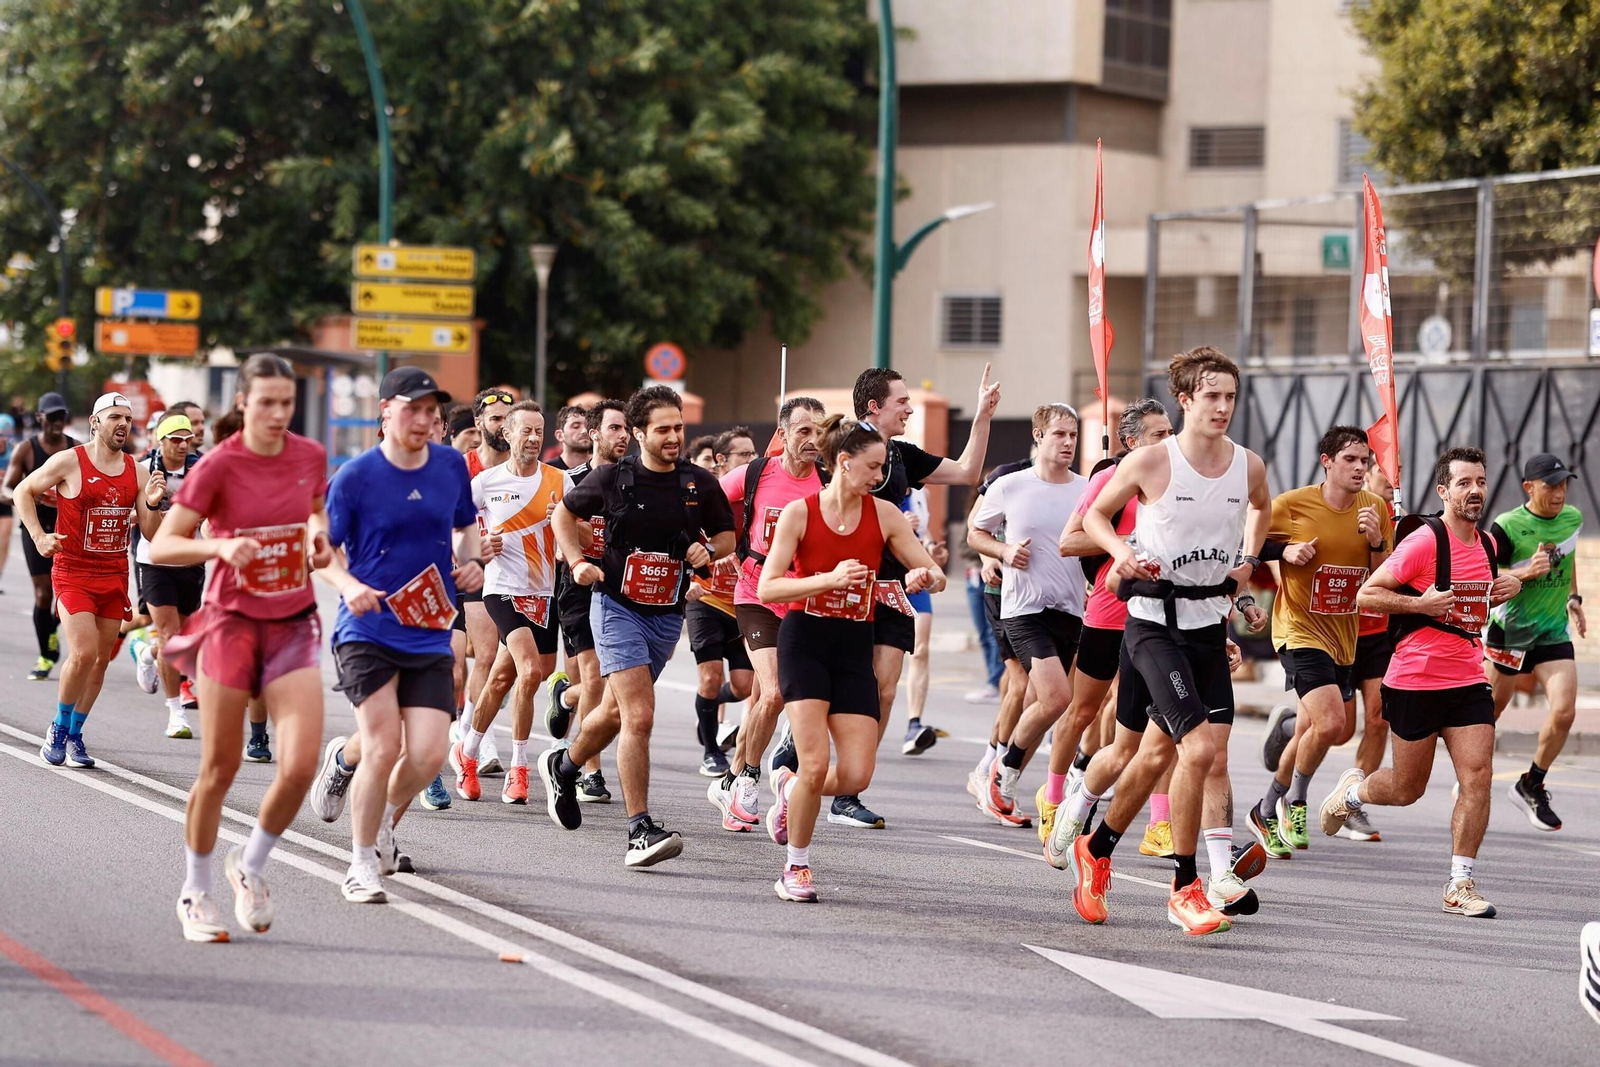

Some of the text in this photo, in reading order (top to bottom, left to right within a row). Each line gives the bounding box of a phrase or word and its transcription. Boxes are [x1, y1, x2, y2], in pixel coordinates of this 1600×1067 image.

[101, 519, 118, 528] 537
[640, 565, 668, 577] 3665
[1328, 578, 1347, 587] 836
[1170, 671, 1189, 699] OMM
